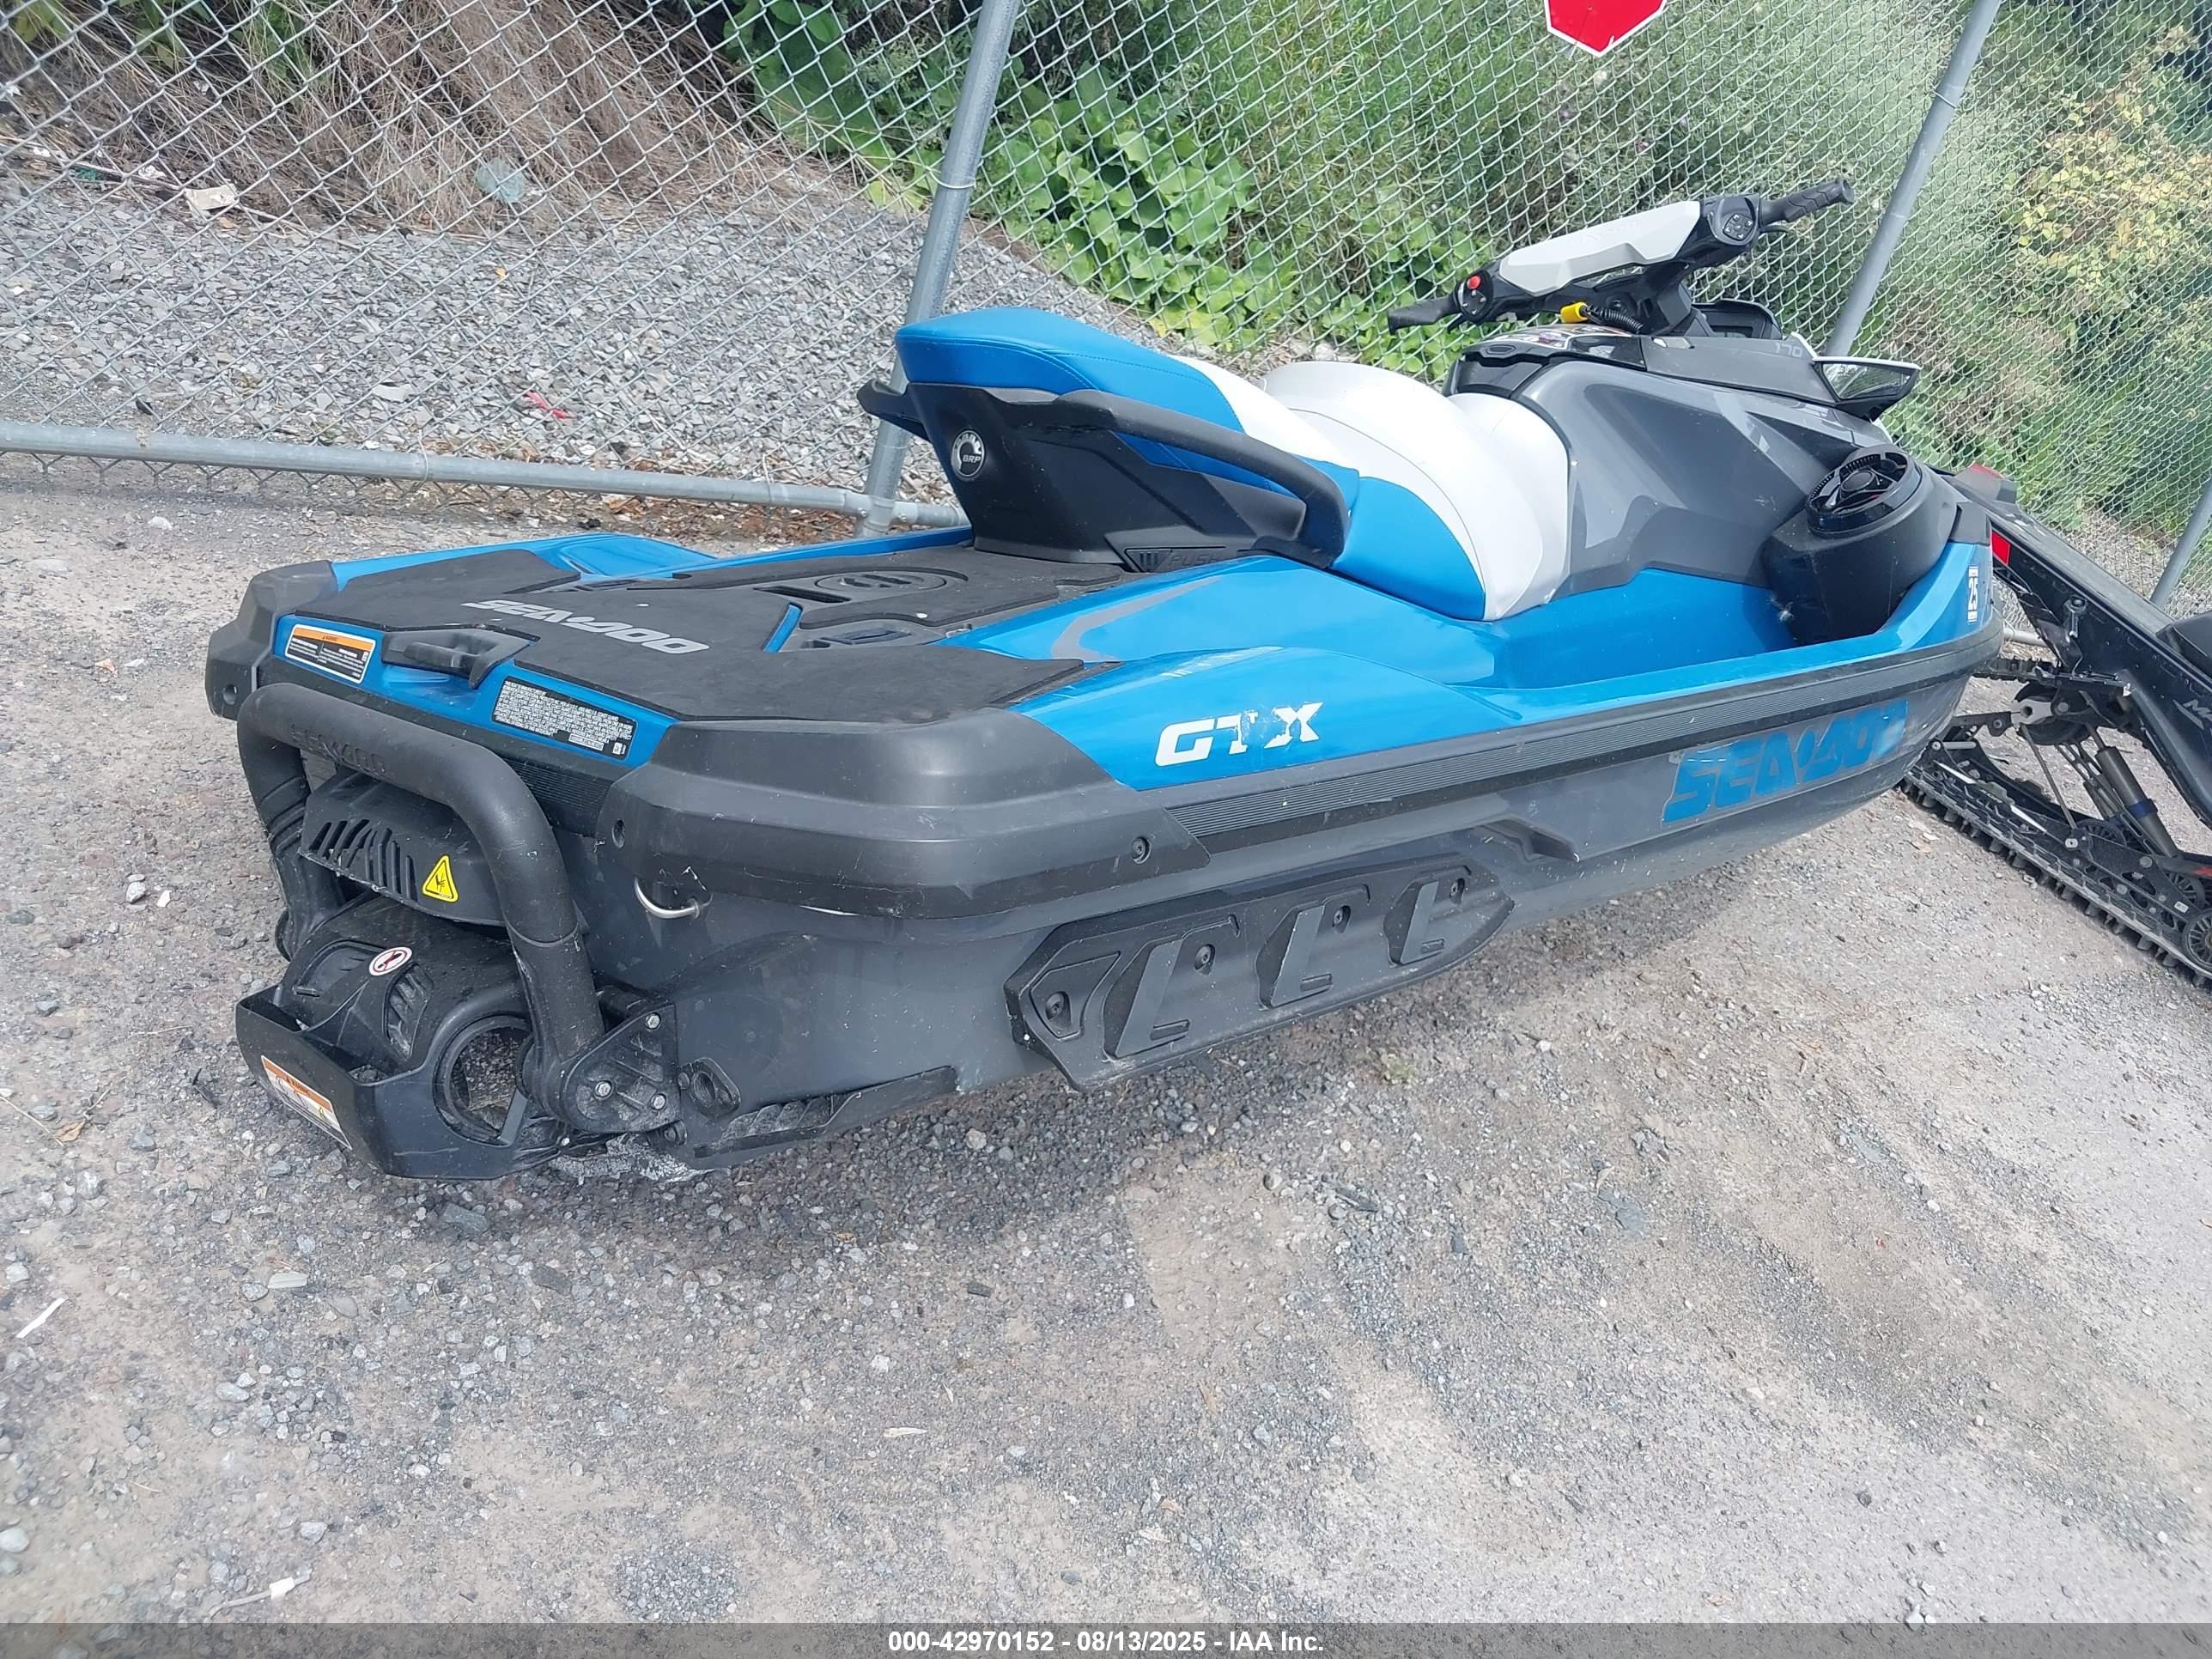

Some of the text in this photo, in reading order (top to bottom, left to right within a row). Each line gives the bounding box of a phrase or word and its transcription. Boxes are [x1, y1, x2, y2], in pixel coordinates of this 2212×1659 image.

[1774, 343, 1803, 358] 170
[963, 454, 981, 464] BRP
[1155, 701, 1323, 767] GTX
